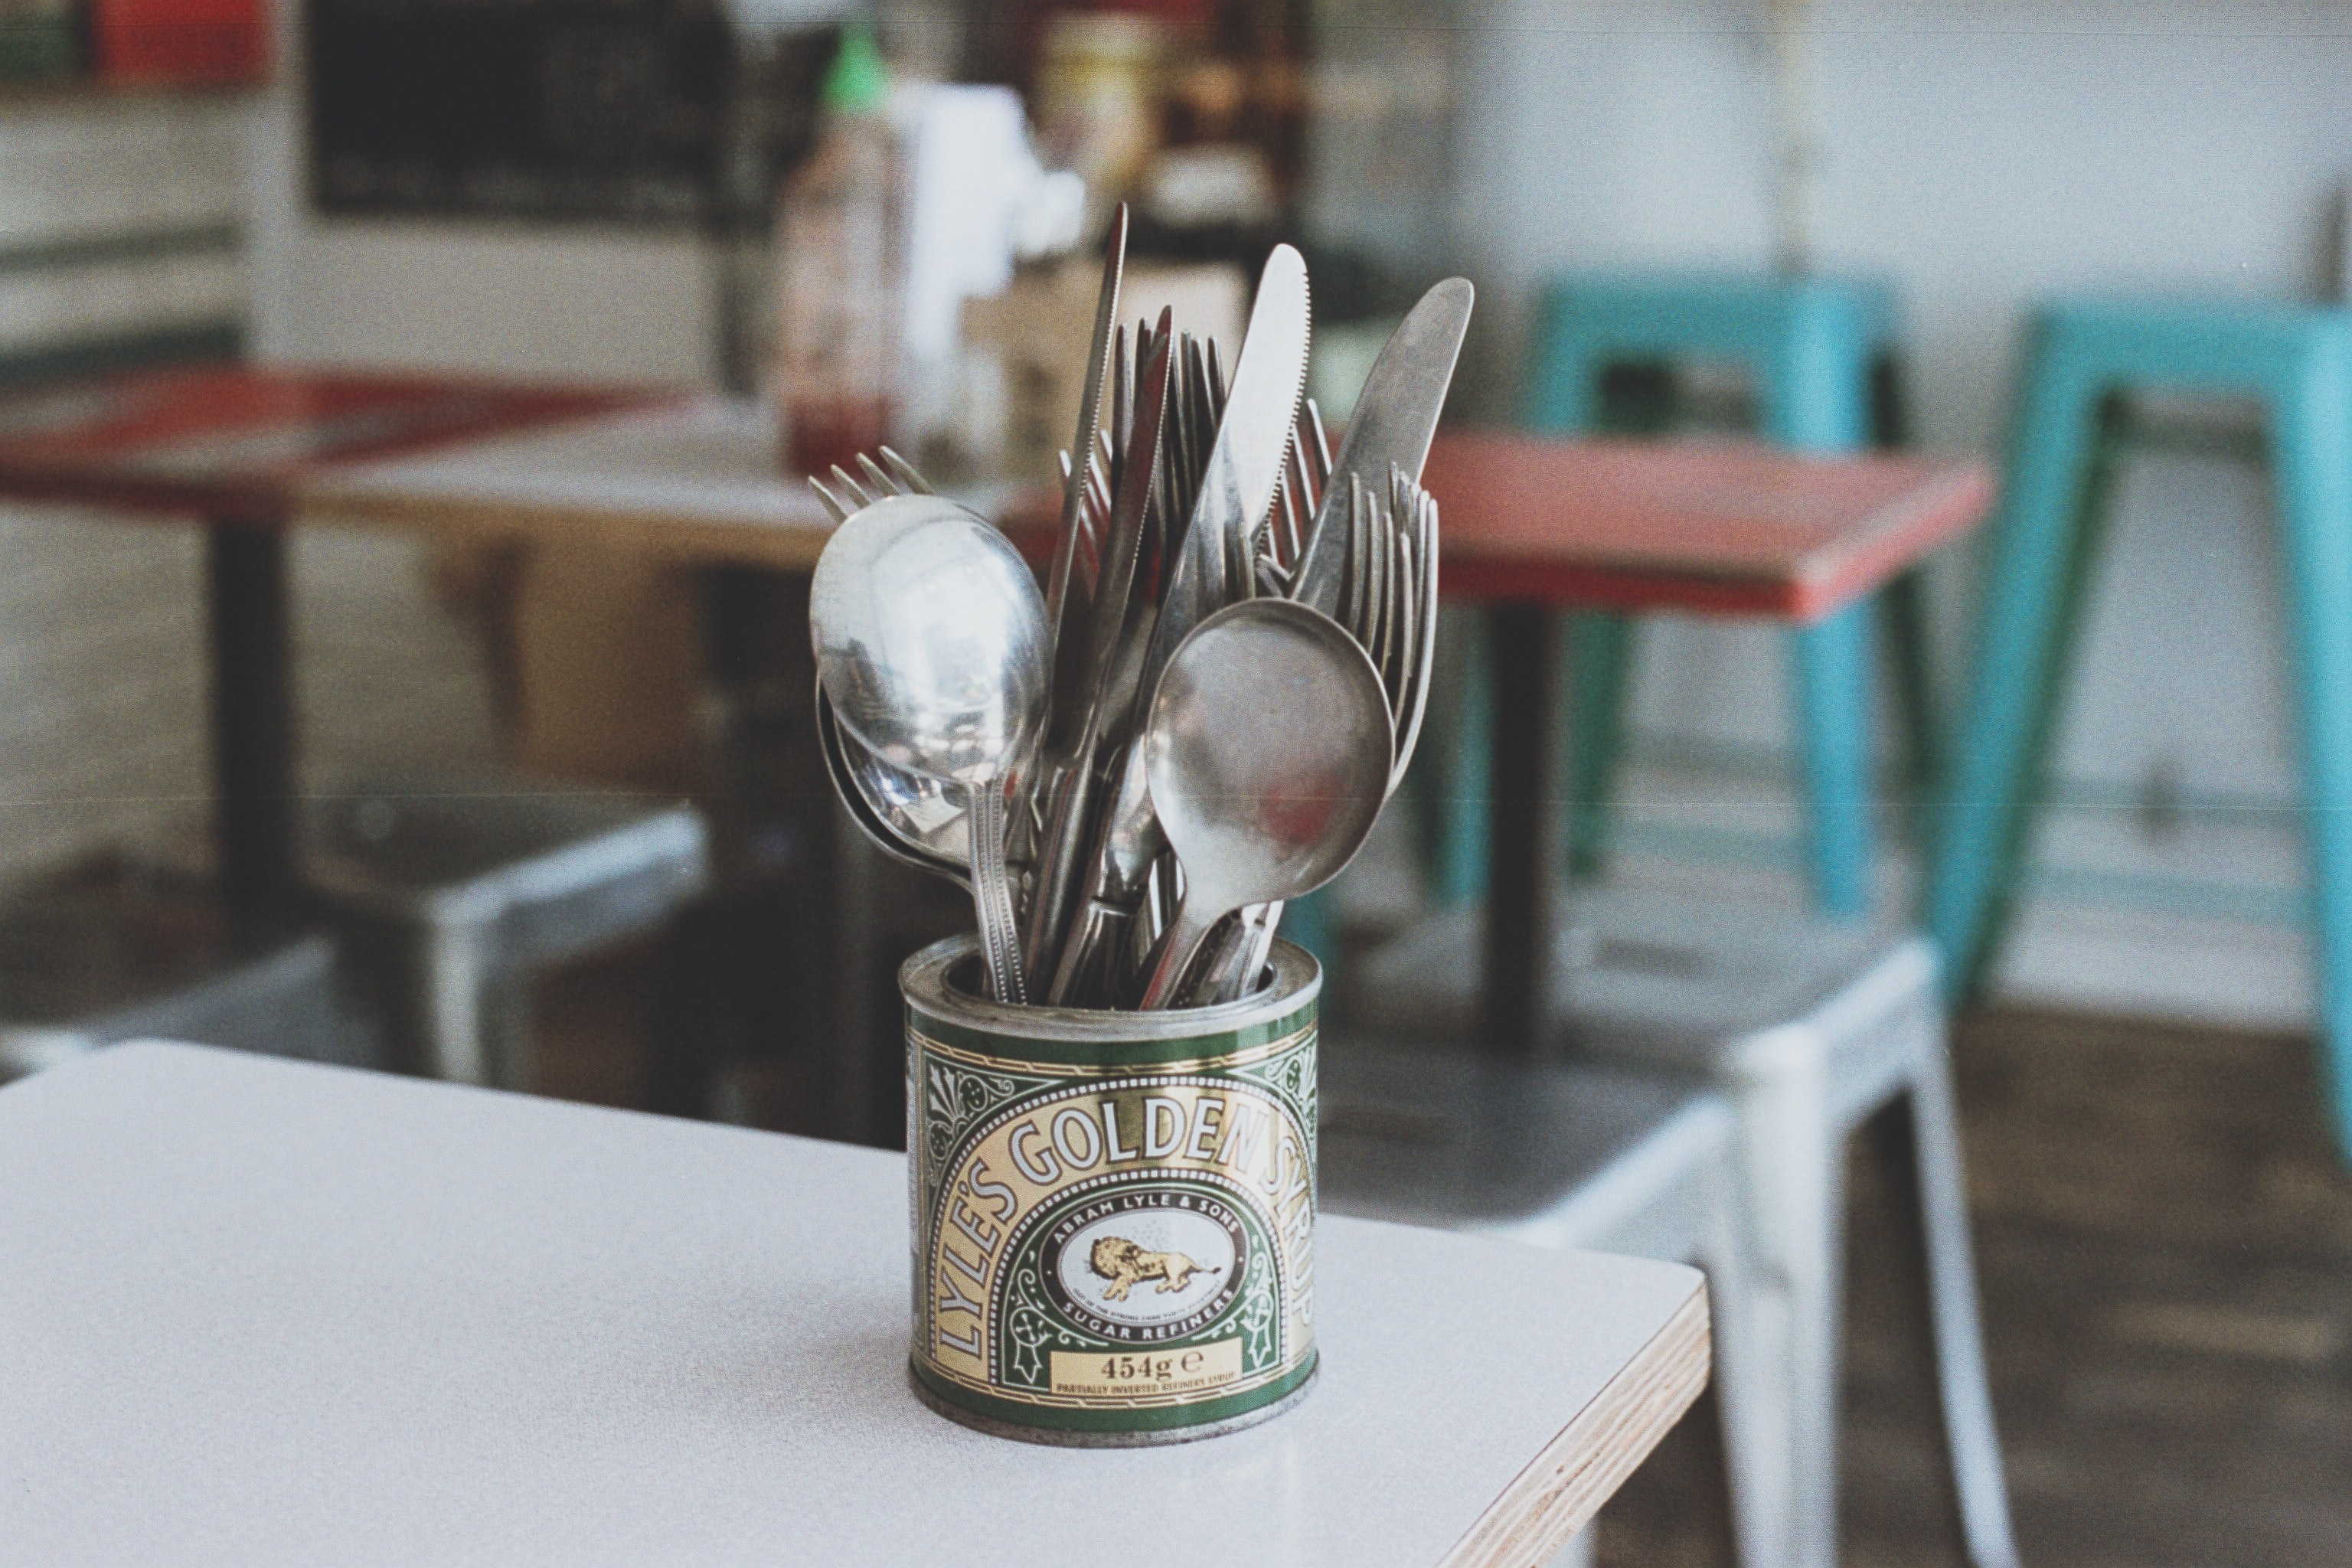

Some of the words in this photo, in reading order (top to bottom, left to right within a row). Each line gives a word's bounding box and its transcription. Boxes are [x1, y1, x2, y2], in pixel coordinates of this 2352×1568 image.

[939, 1157, 1019, 1360] LYLE'S
[1008, 1095, 1268, 1186] GOLDEN
[1258, 1135, 1314, 1327] SYRUP
[1054, 1201, 1115, 1244] ABRAM
[1123, 1194, 1171, 1209] LYLE
[1180, 1194, 1191, 1208] &
[1200, 1200, 1240, 1233] SONS
[1062, 1302, 1132, 1340] SUGAR
[1142, 1289, 1235, 1340] REFINERS
[1101, 1357, 1172, 1382] 454g
